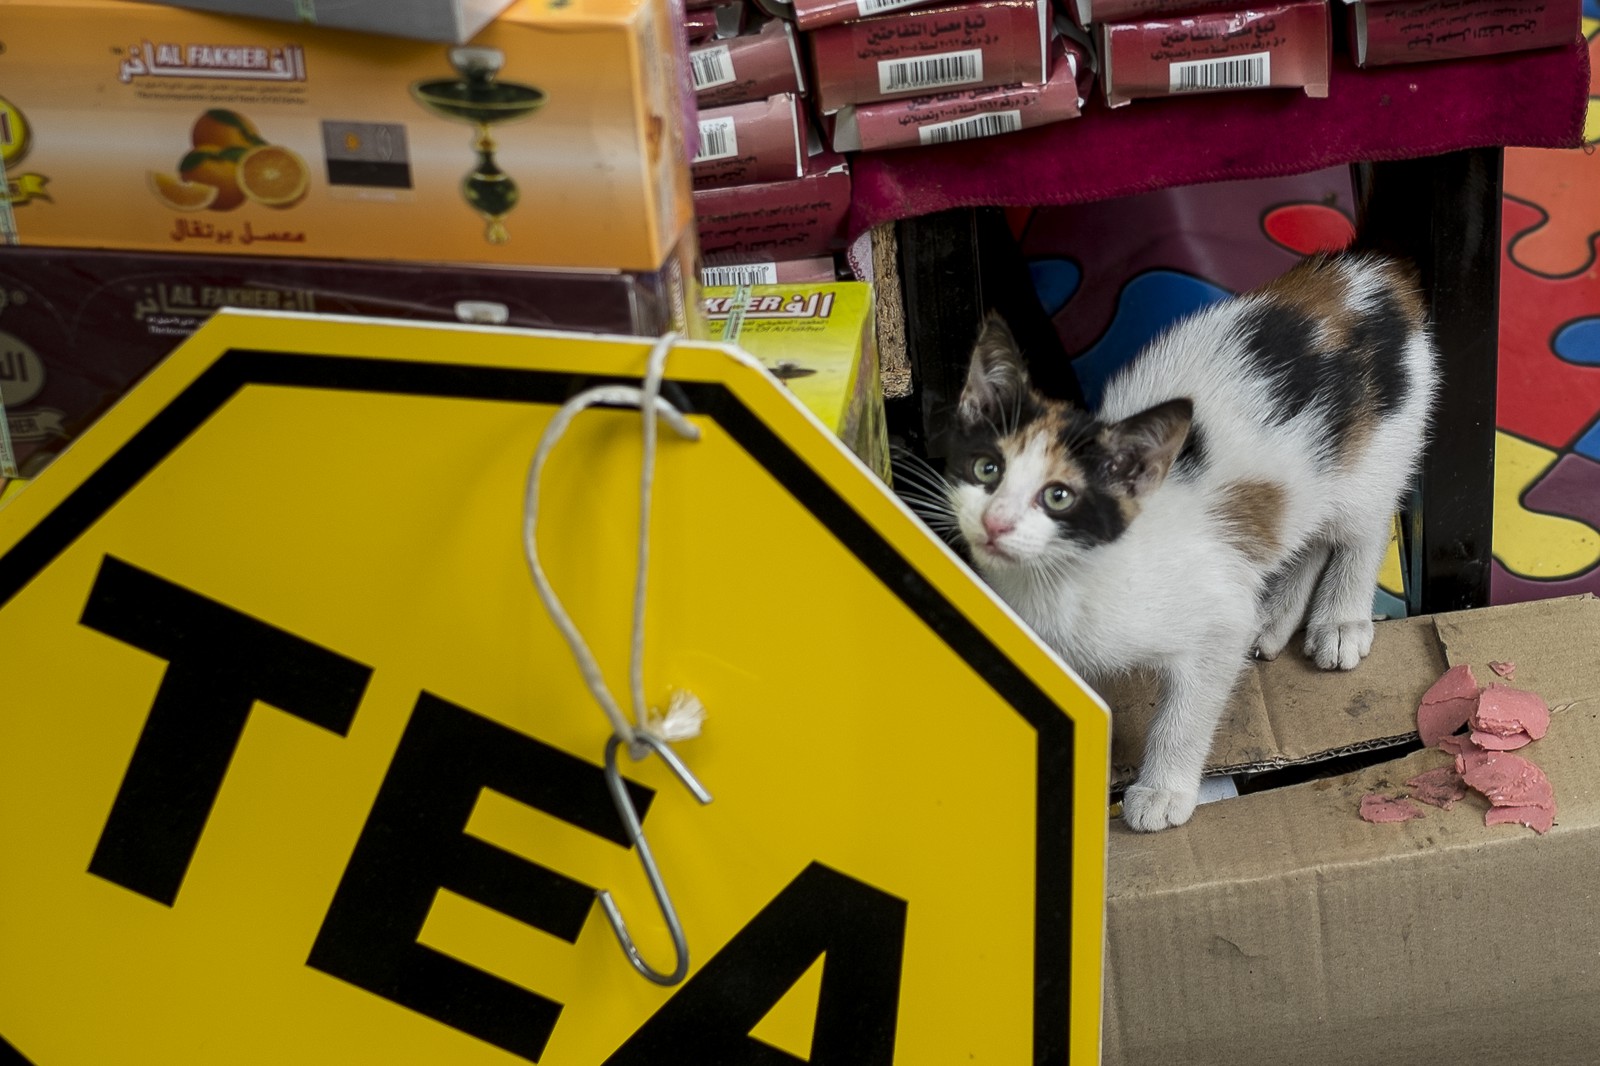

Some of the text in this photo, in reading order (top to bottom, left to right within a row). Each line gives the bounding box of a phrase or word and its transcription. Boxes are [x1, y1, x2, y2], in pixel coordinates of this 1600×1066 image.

[867, 14, 986, 46] تبغ معسل التفاحتين
[1255, 18, 1276, 38] تبغ
[1436, 27, 1470, 43] معسل
[156, 46, 269, 69] AL FAKHER
[170, 218, 306, 244] معسل برتقال
[171, 286, 280, 308] AL FAKHER
[79, 553, 909, 1066] TEA
